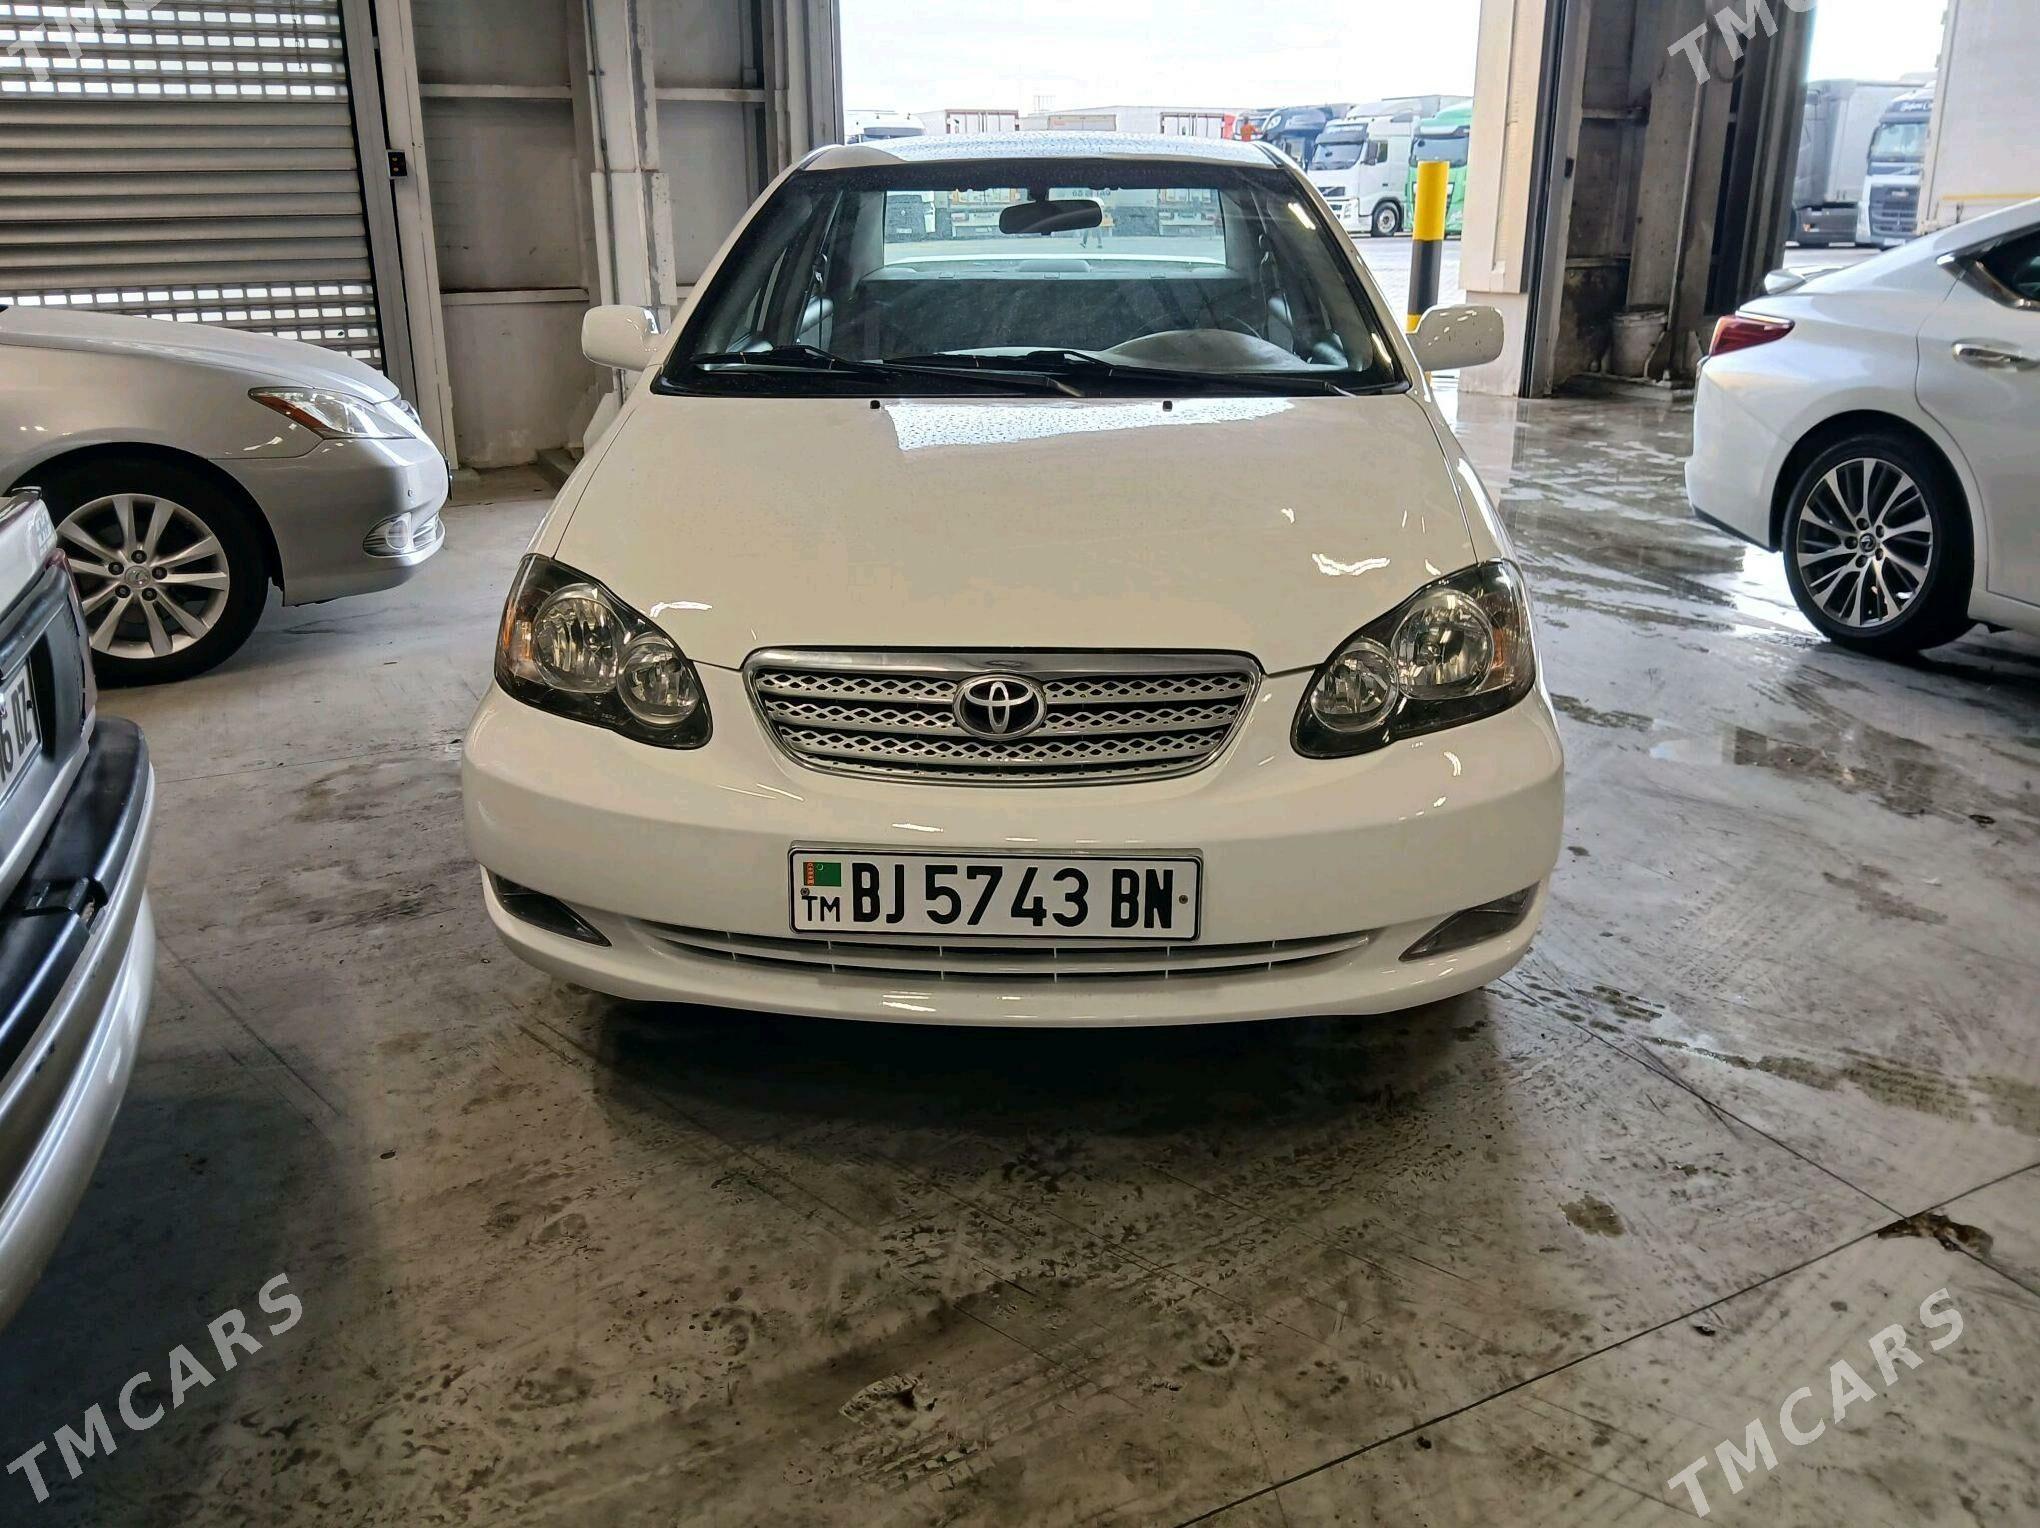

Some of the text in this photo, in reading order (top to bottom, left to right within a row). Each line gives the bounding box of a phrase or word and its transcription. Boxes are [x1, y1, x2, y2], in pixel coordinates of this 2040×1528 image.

[801, 895, 841, 923] TM
[851, 862, 1174, 929] BJ 5743 BN
